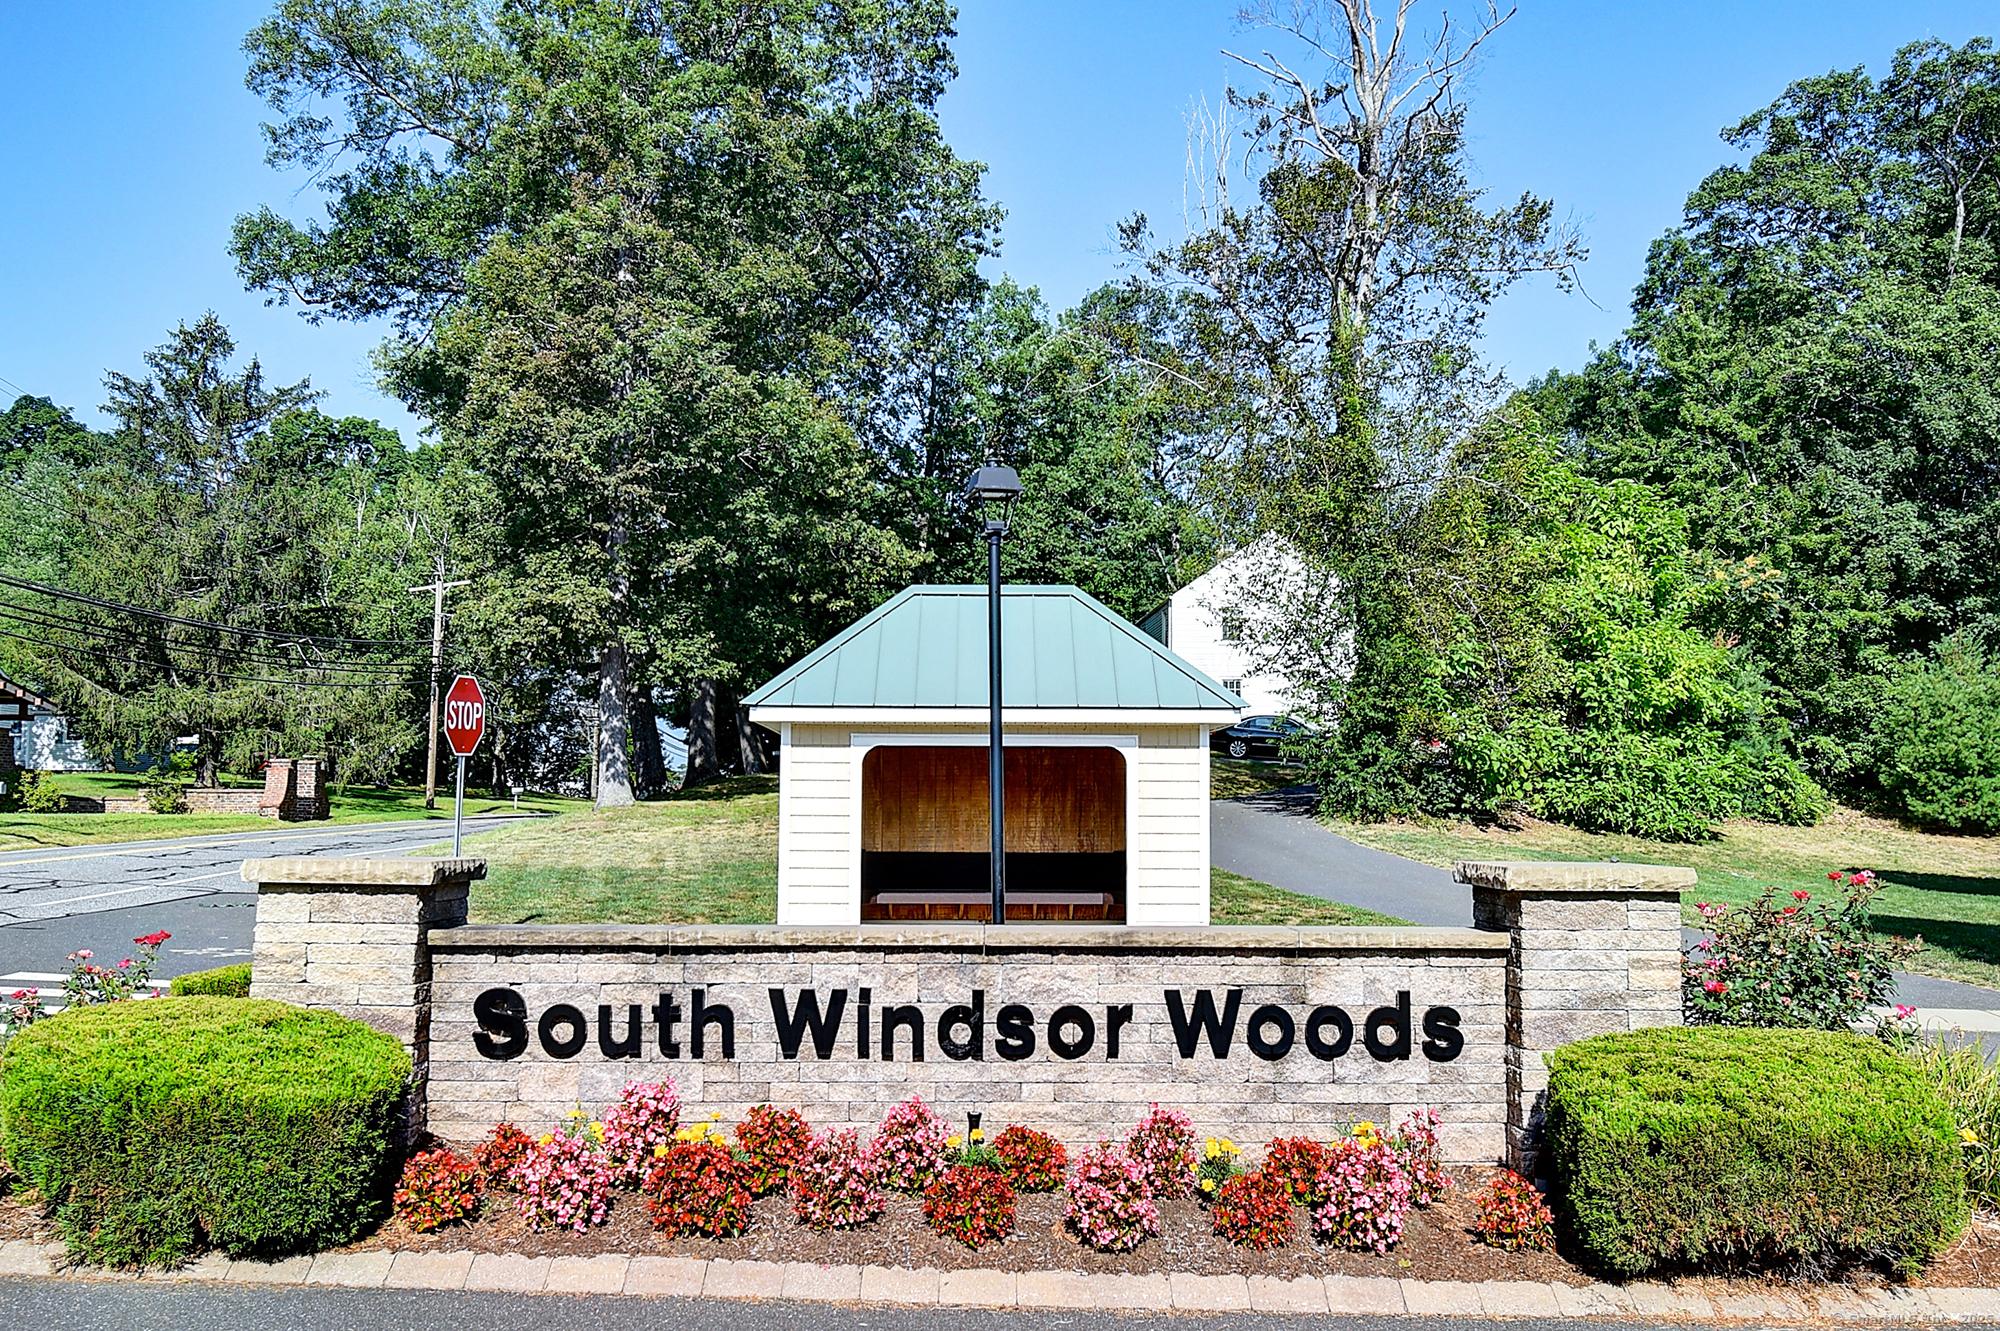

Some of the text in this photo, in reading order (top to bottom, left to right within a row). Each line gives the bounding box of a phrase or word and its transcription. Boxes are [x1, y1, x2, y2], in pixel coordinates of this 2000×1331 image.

[448, 700, 482, 730] STOP
[472, 987, 1464, 1062] South Windsor Woods
